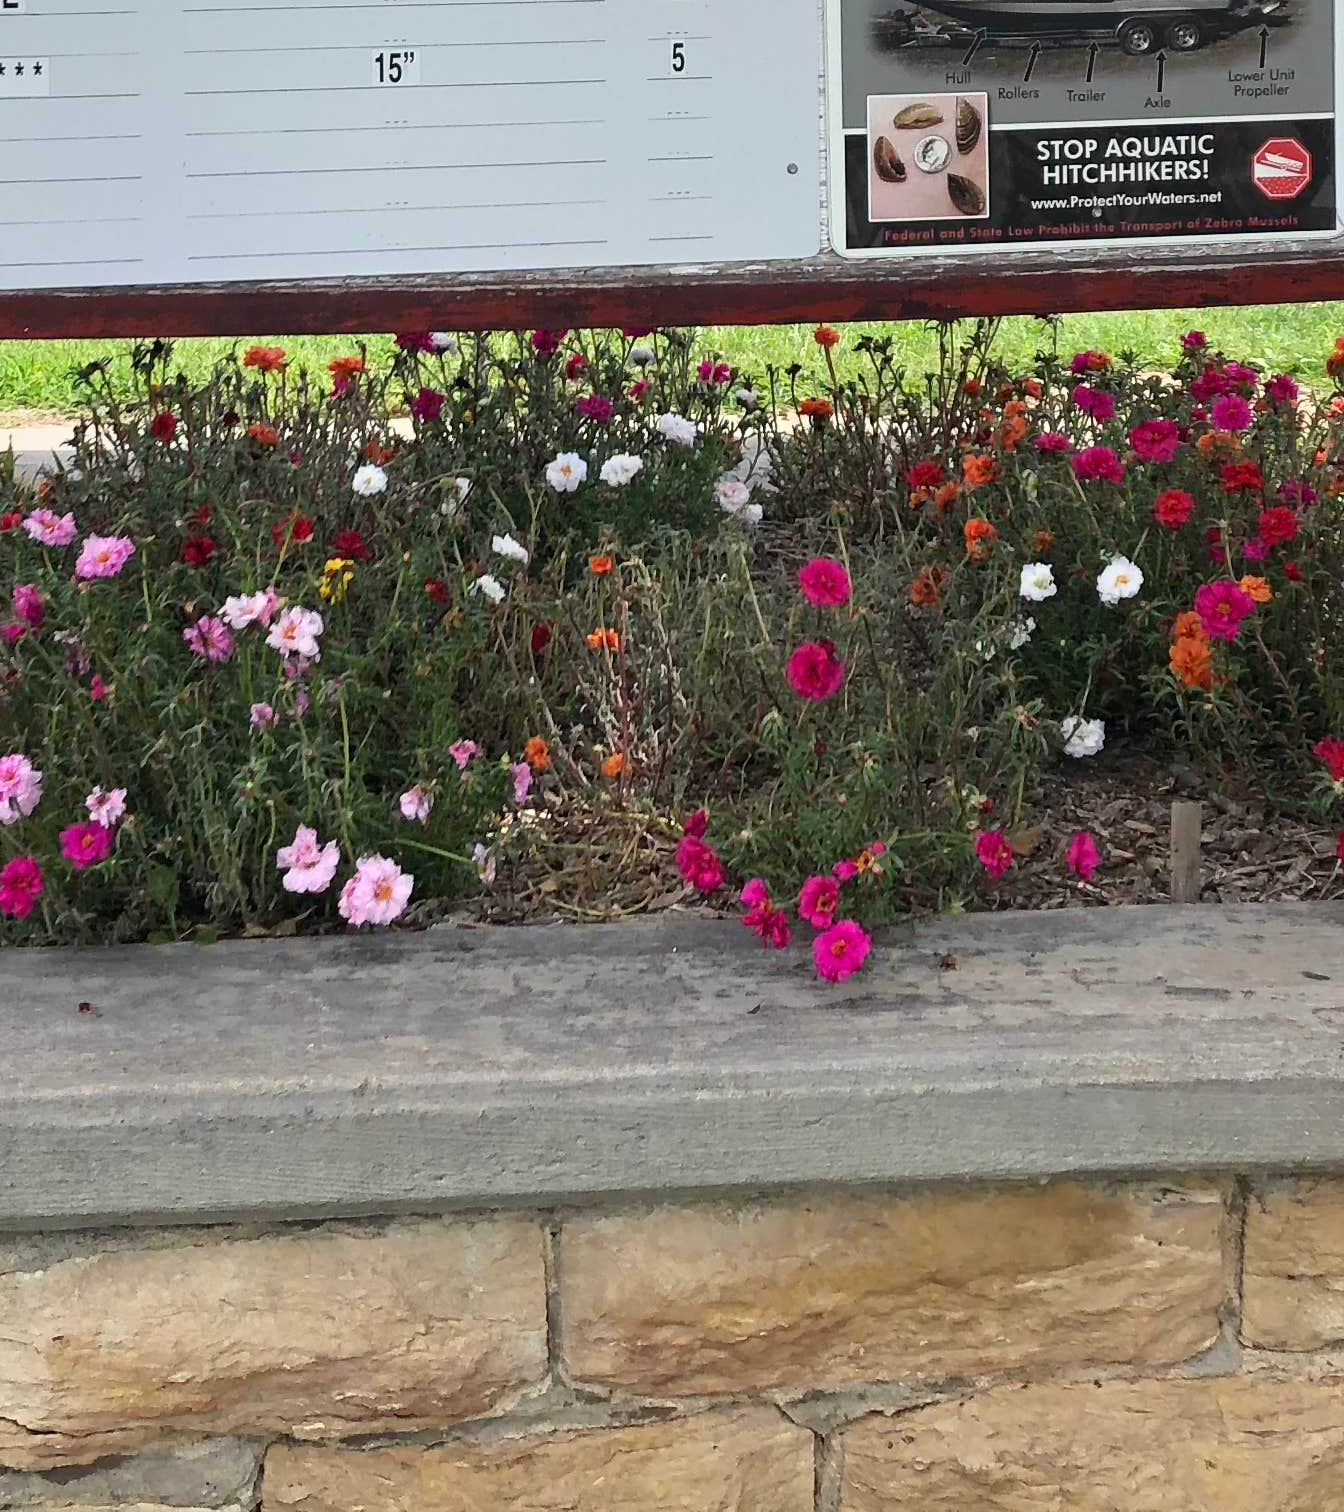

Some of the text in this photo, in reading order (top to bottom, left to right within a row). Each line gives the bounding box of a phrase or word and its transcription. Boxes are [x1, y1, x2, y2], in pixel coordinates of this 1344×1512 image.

[672, 42, 685, 72] 5
[946, 71, 971, 84] Hull
[1228, 68, 1295, 82] Lower Unit
[998, 87, 1040, 100] Rollers
[1067, 90, 1106, 102] Trailer
[1234, 83, 1289, 97] Propeller
[1144, 96, 1171, 108] Axle
[1037, 135, 1214, 161] STOP AQUATIC
[1042, 159, 1209, 185] HITCHHIKERS!
[1031, 191, 1222, 211] www.ProtectYourWaters.net
